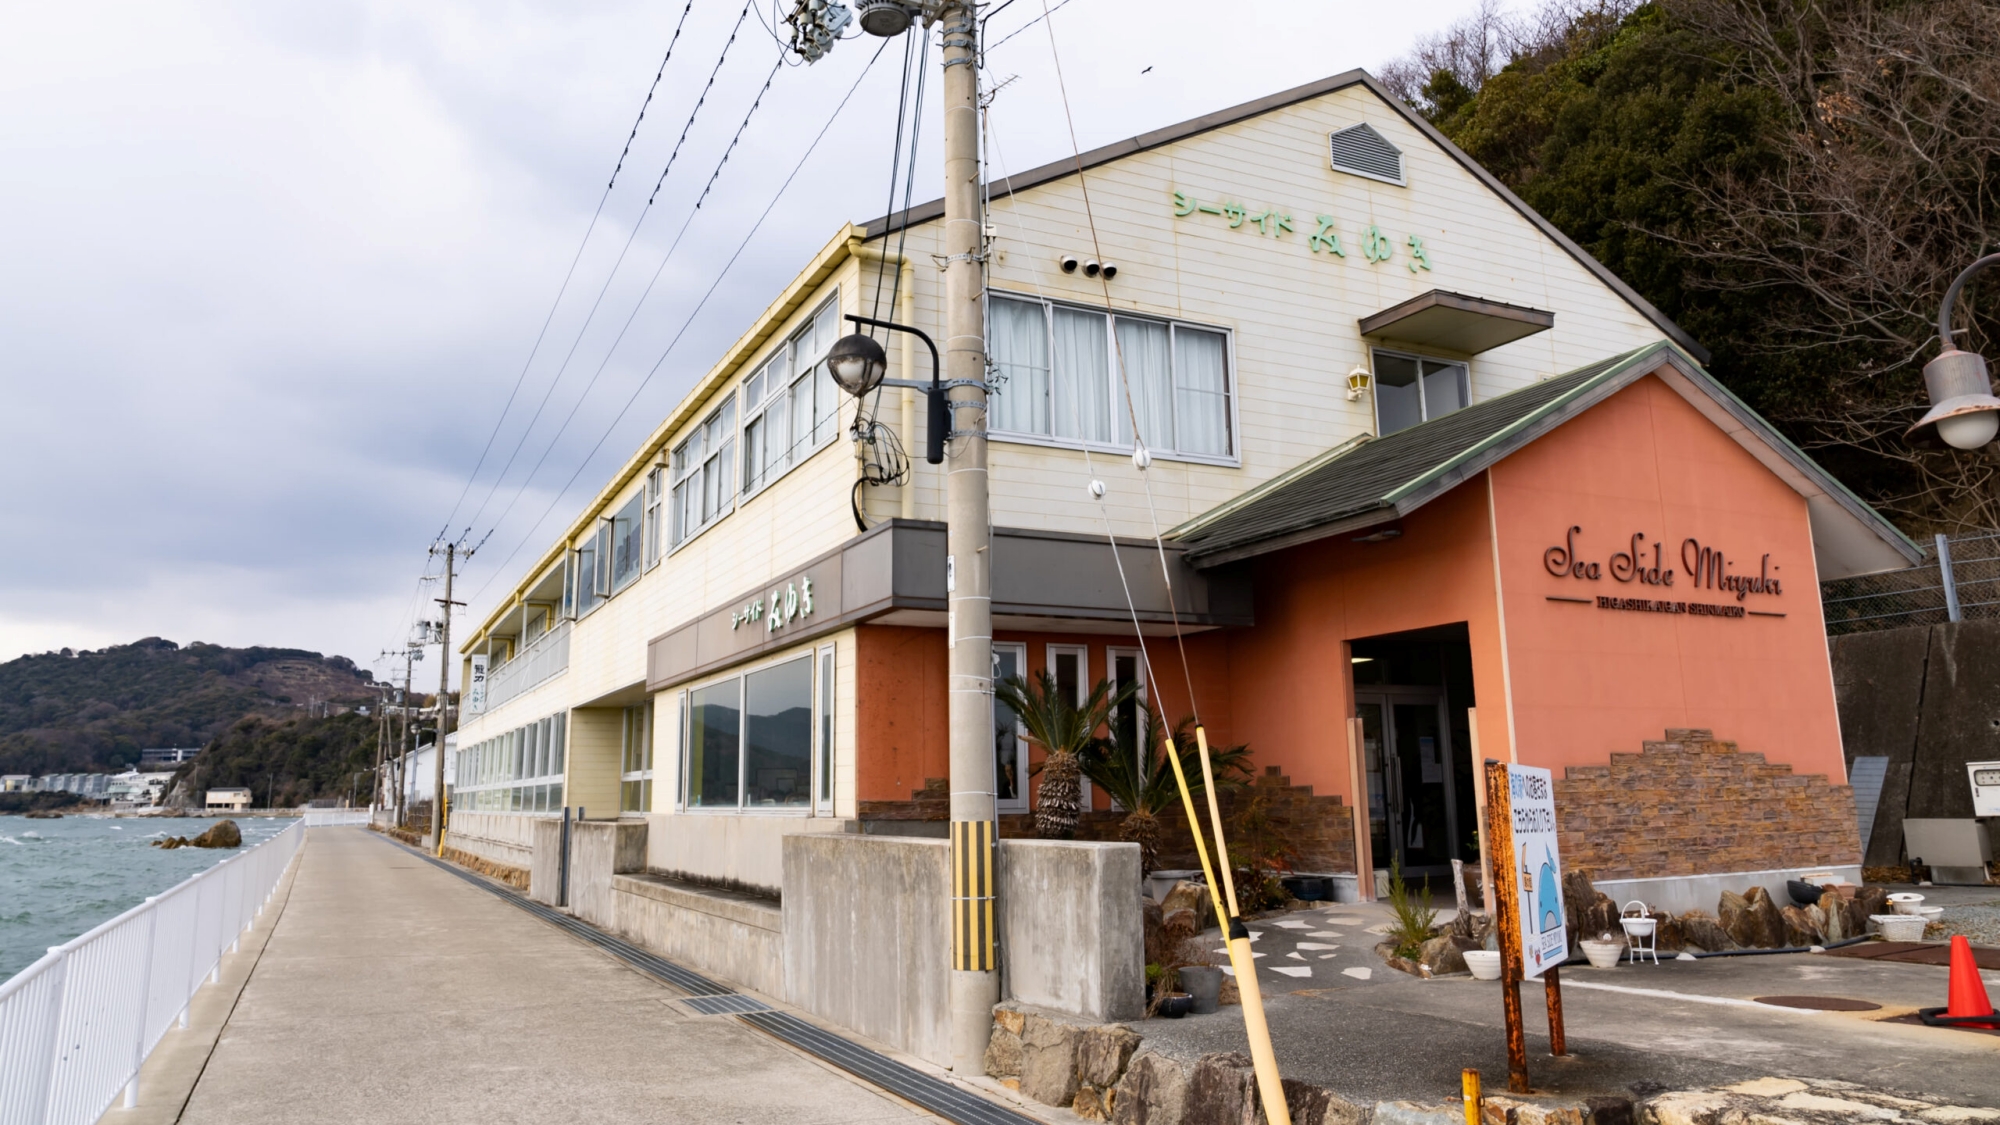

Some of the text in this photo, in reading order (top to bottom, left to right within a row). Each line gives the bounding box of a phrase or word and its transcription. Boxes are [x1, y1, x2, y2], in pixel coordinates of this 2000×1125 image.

[1174, 191, 1431, 273] シーサイド みゆき
[1543, 525, 1783, 601] Sea Side Miyuki
[731, 576, 814, 632] シーサイド みゆき
